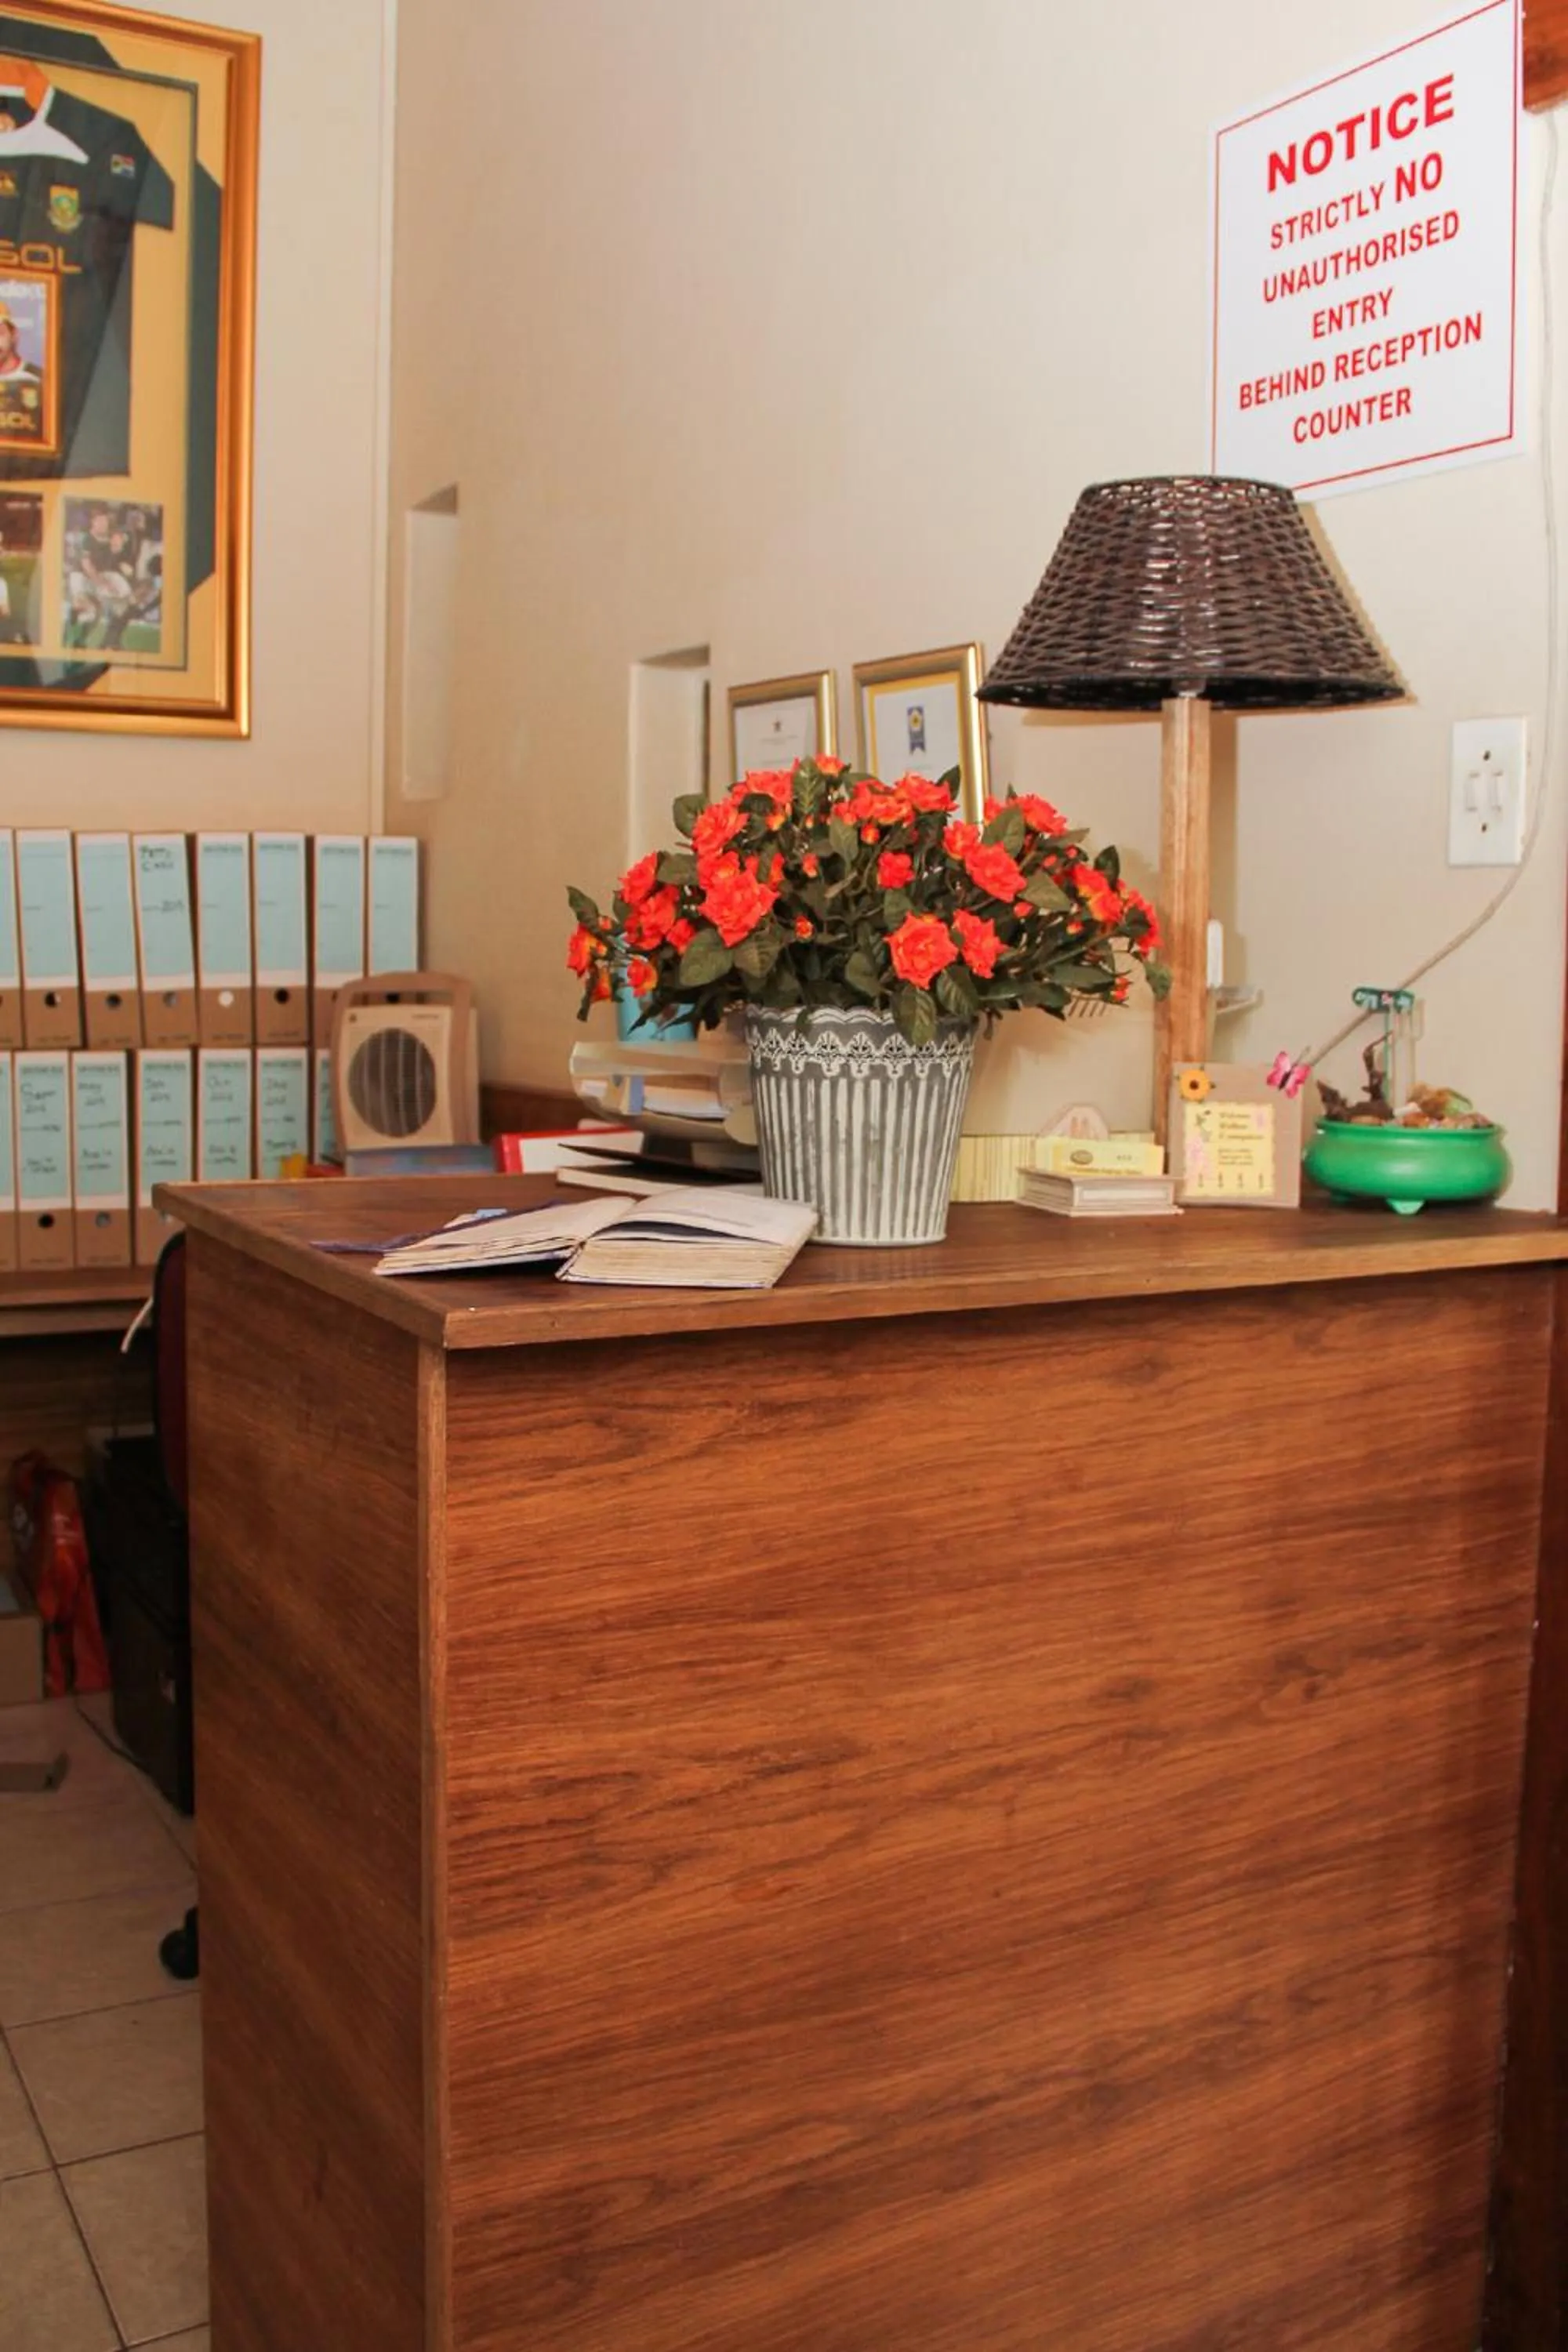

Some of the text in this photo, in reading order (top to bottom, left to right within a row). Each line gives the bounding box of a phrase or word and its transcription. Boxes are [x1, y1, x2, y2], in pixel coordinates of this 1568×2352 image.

[1266, 74, 1455, 193] NOTICE
[1270, 151, 1444, 250] STRICTLY NO
[1263, 209, 1460, 303] UNAUTHORISED
[1240, 313, 1483, 411] BEHIND RECEPTION
[1312, 288, 1393, 340] ENTRY
[1292, 387, 1412, 445] COUNTER
